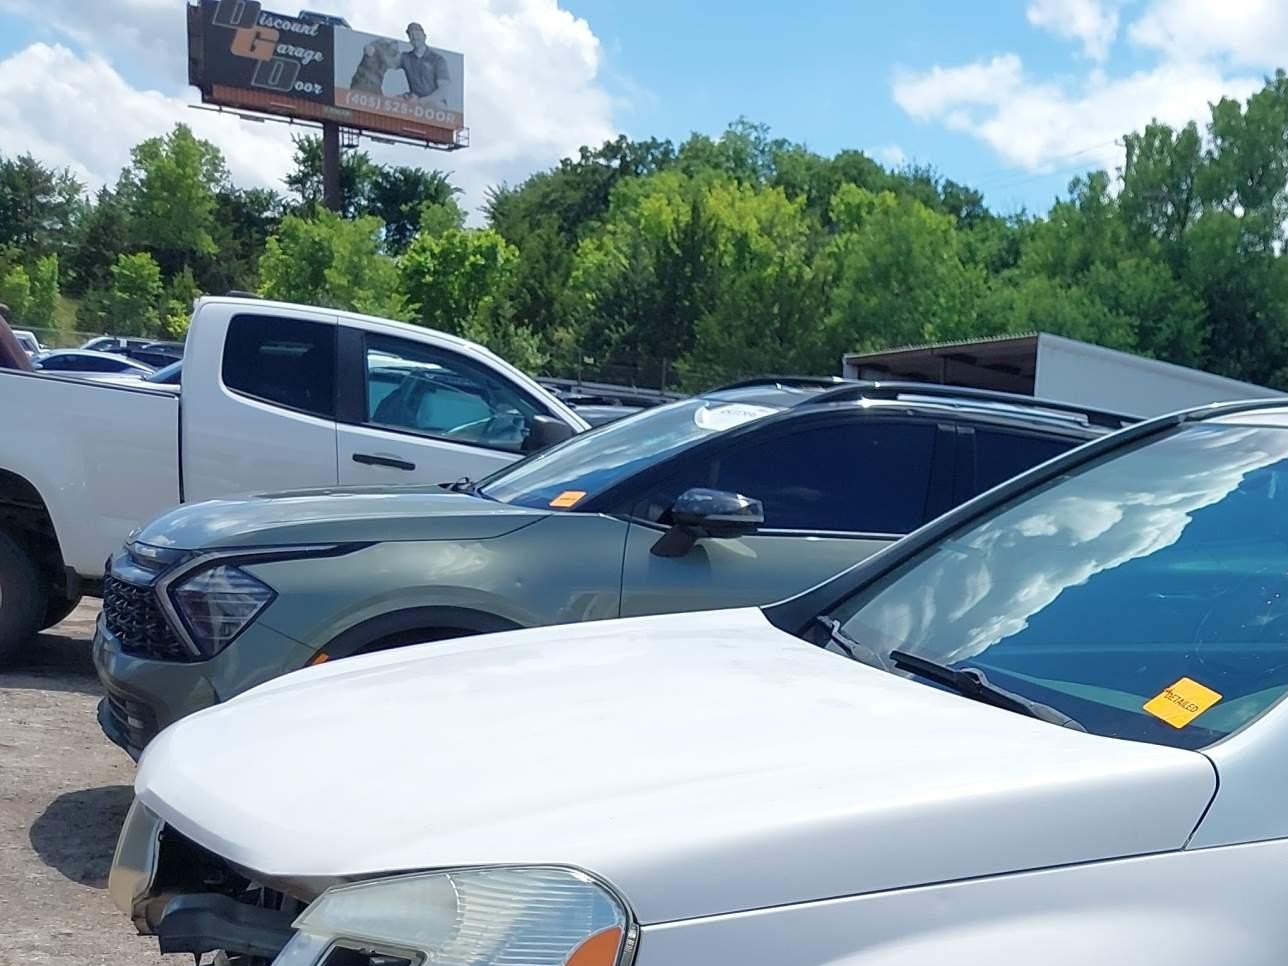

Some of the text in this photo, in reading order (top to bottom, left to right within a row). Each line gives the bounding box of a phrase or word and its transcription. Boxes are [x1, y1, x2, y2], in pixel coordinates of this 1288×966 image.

[211, 0, 320, 37] Discount
[230, 26, 324, 65] Garage
[251, 56, 323, 95] Door
[345, 92, 381, 110] (405)
[1164, 691, 1199, 713] DETAILED
